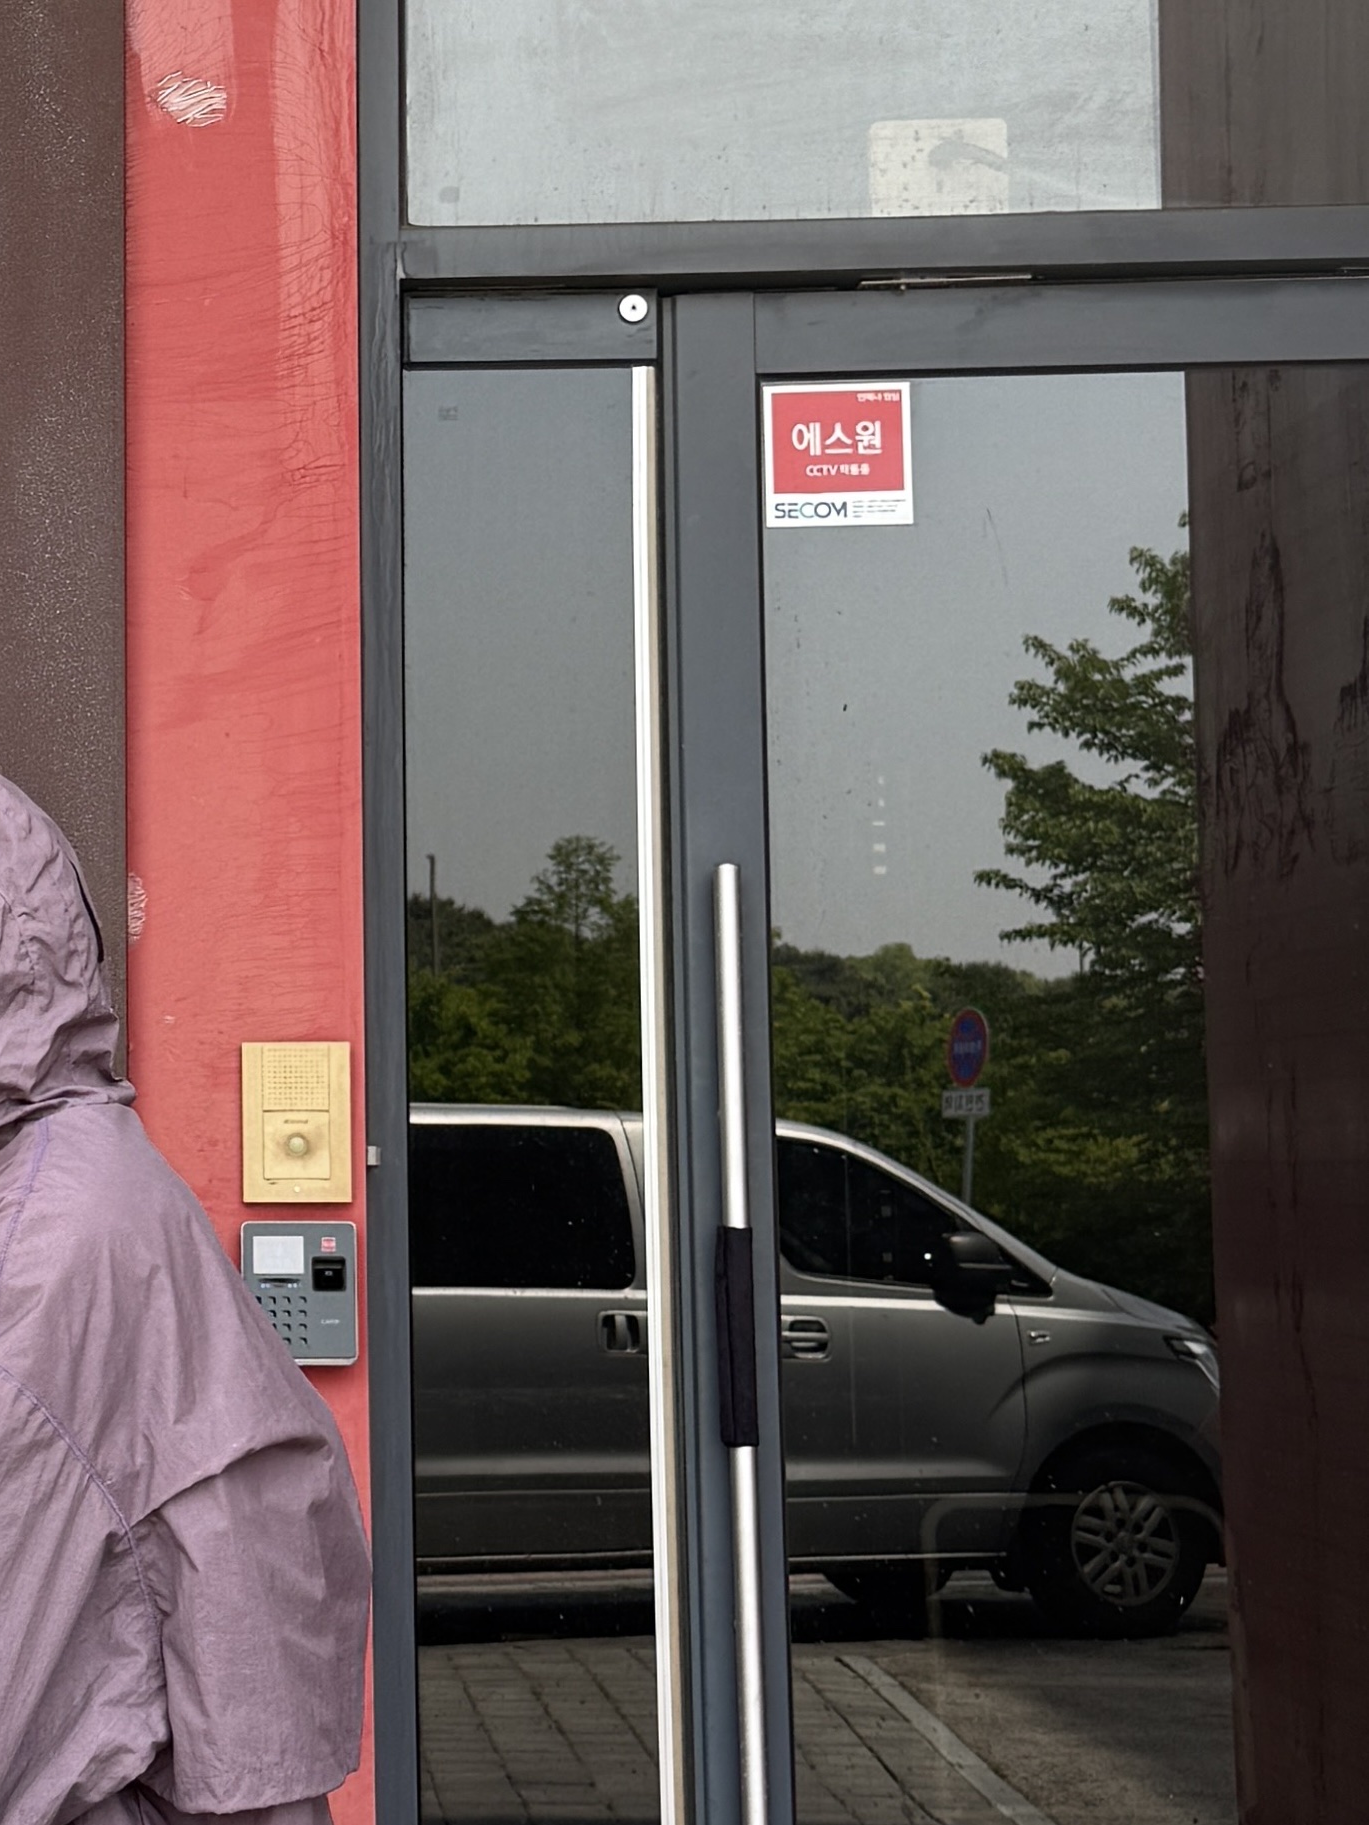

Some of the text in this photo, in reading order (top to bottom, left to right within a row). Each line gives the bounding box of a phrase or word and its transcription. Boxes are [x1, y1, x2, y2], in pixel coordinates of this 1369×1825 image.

[791, 420, 883, 457] 에스원
[806, 464, 838, 476] CCTV
[774, 501, 848, 519] SECOM
